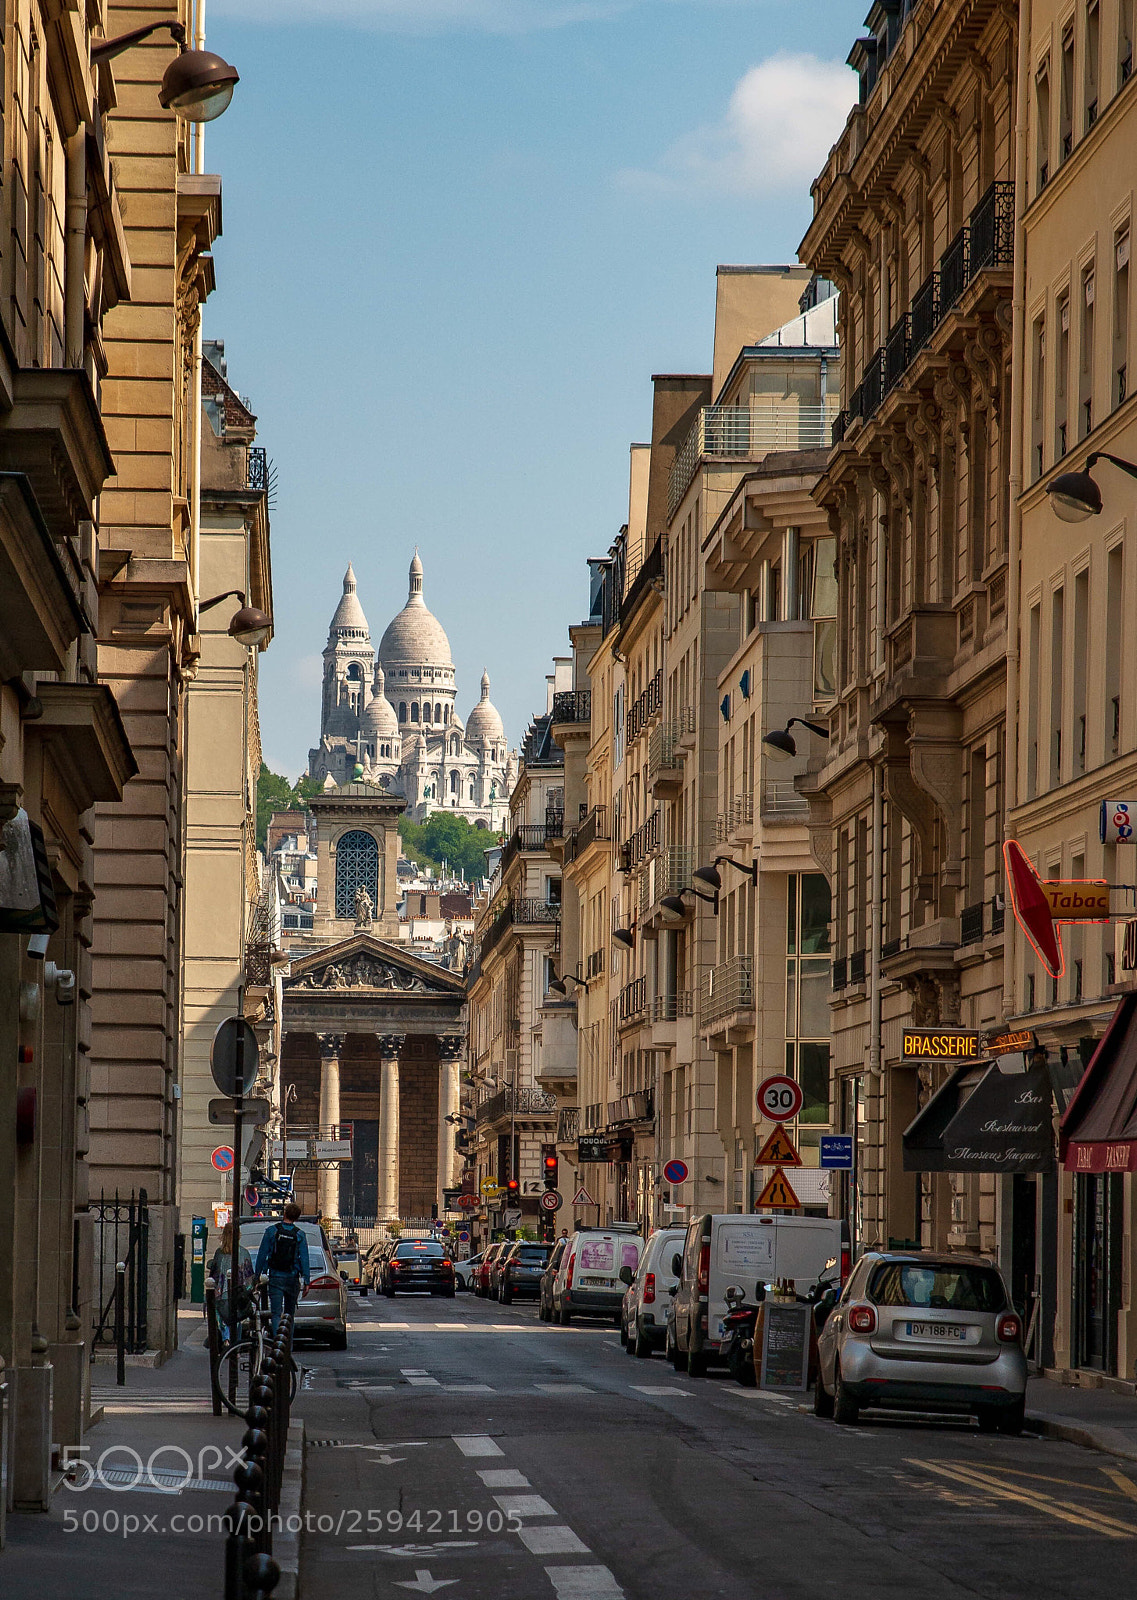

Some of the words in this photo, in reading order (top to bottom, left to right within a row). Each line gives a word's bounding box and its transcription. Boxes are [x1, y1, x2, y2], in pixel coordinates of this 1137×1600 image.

[1049, 892, 1106, 908] Tabac
[904, 1035, 977, 1056] BRASSERIE
[767, 1089, 793, 1108] 30
[1014, 1090, 1043, 1104] Bar
[980, 1119, 1043, 1132] Restaurant
[947, 1147, 1001, 1160] Monsieur
[994, 1147, 1041, 1163] Jacques
